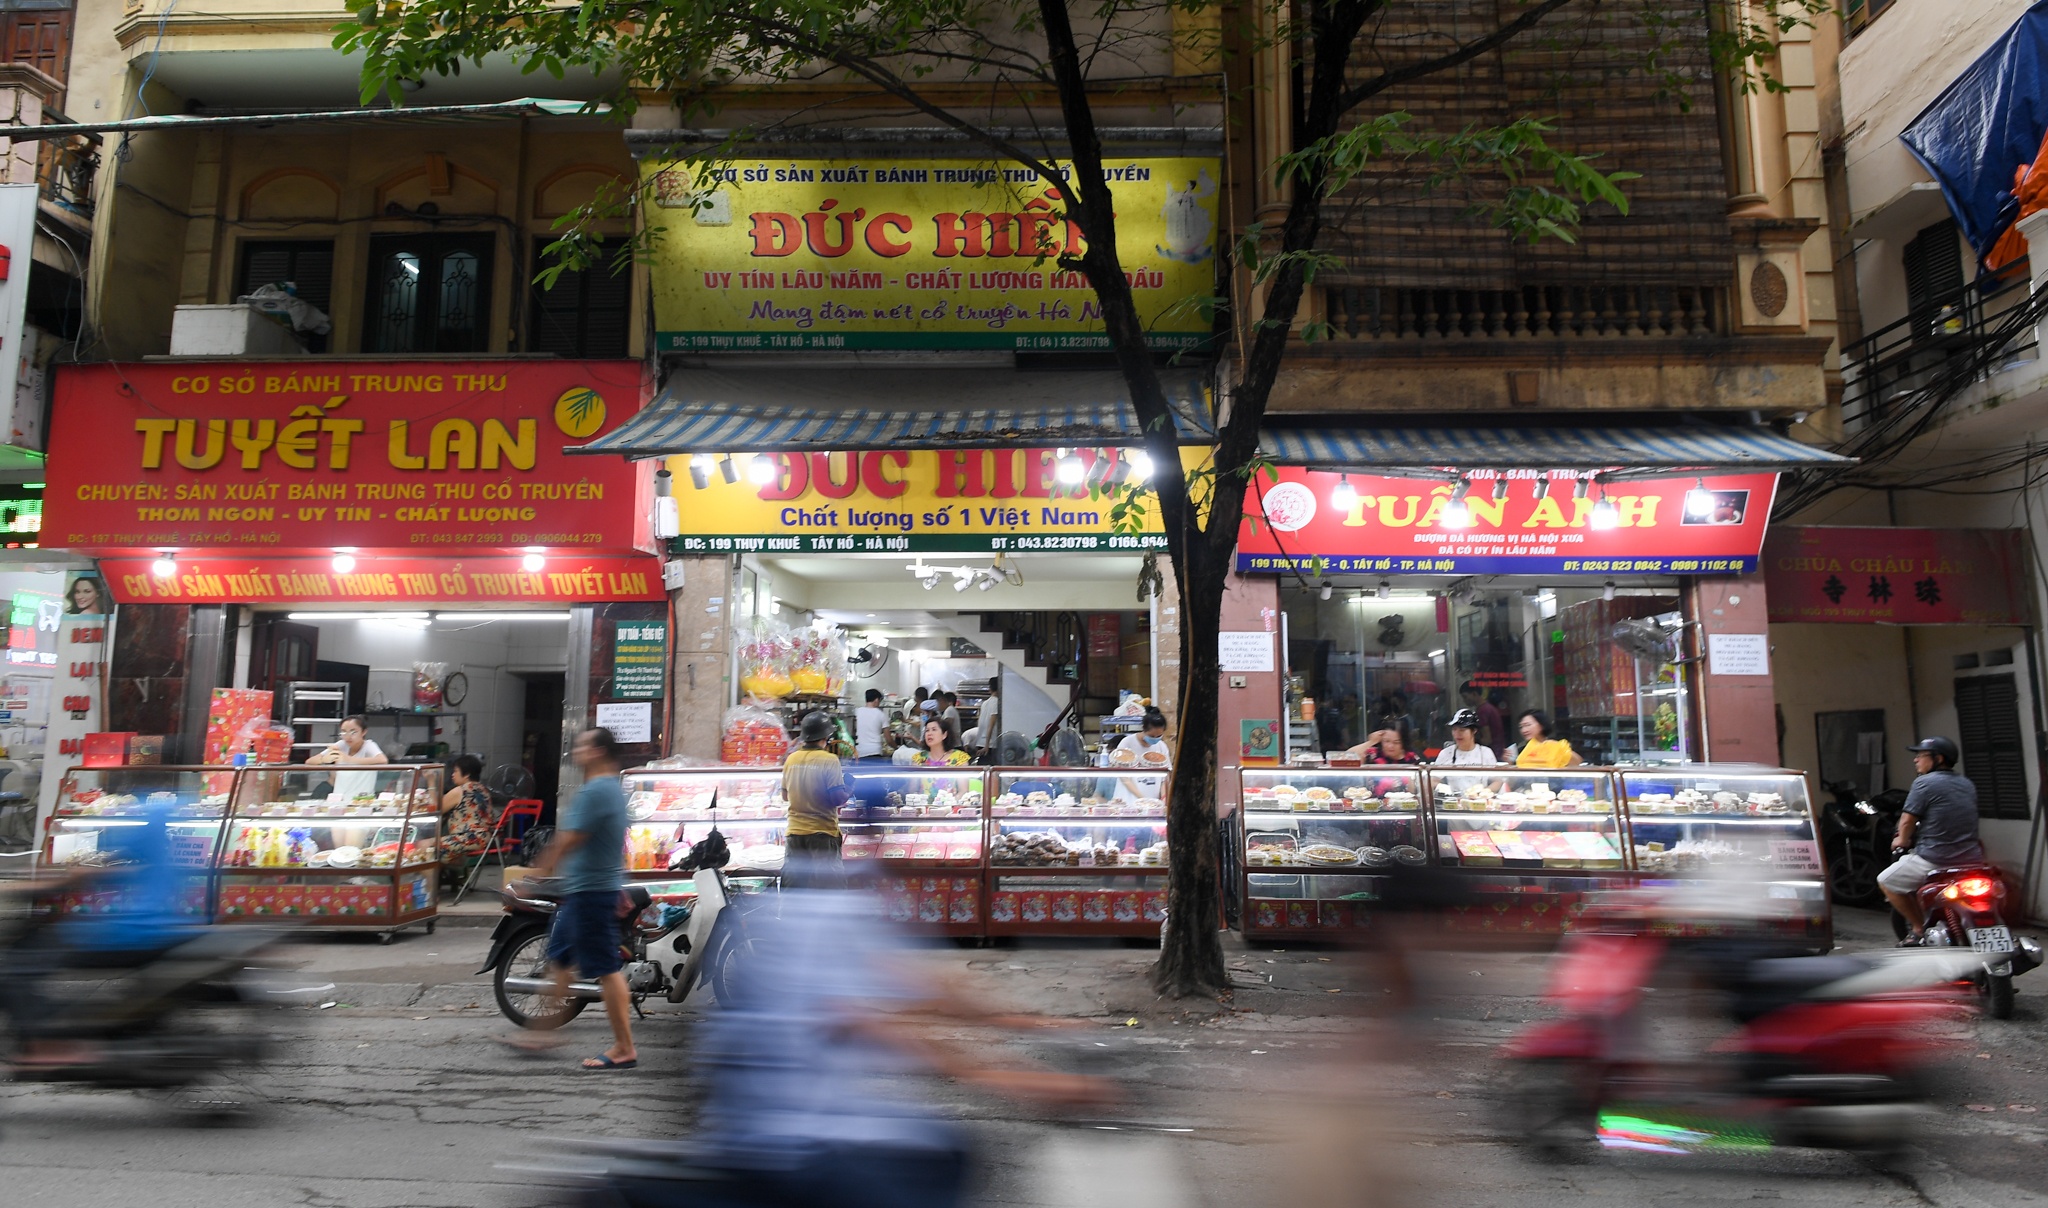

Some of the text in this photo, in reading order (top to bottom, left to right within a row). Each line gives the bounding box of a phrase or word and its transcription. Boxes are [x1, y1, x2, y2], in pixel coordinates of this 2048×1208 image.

[743, 164, 769, 182] SỞ
[775, 164, 814, 182] SẢN
[820, 164, 869, 182] XUẤT
[875, 165, 927, 182] BÁNH
[934, 169, 997, 183] TRUNG
[749, 198, 913, 258] ĐỨC
[704, 272, 732, 289] UY
[739, 269, 775, 289] TÍN
[782, 269, 823, 289] LÂU
[831, 269, 882, 289] NĂM
[906, 267, 962, 289] CHẤT
[969, 271, 1042, 293] LƯỢNG
[748, 300, 815, 328] Mang
[819, 301, 866, 325] đậm
[874, 301, 914, 320] nét
[921, 300, 948, 320] cổ
[955, 301, 1031, 328] truyền
[1036, 299, 1071, 321] Hà
[691, 336, 709, 346] 199
[171, 369, 507, 394] CƠ SỞ BÁNH TRUNG THU
[134, 395, 537, 470] TUYẾT LAN
[77, 481, 168, 501] CHUYÊN:
[175, 479, 218, 500] SẢN
[224, 477, 280, 500] XUẤT
[287, 480, 346, 500] BÁNH
[355, 483, 426, 500] TRUNG
[433, 483, 475, 500] THU
[482, 476, 512, 500] CỔ
[137, 502, 536, 525] THƠM NGON UY TÍN CHẤT LƯỢNG
[781, 504, 1099, 531] Chất lượng số 1 Việt Nam
[91, 534, 110, 543] 197
[432, 534, 452, 543] 043
[455, 534, 474, 543] 847
[476, 534, 503, 543] 2993
[582, 533, 602, 543] 279
[684, 538, 706, 550] ĐC:
[708, 538, 732, 550] 199
[734, 538, 763, 552] THỤY
[811, 536, 835, 550] TÂY
[866, 535, 883, 549] HÀ
[887, 535, 909, 552] NỘI
[992, 537, 1007, 549] ĐT
[1018, 537, 1097, 549] 043.8230798
[1251, 559, 1269, 569] 199
[1353, 558, 1373, 569] TÂY
[1417, 558, 1432, 570] HÀ
[1435, 558, 1455, 572] NỘI
[1583, 561, 1608, 571] 0243
[1611, 561, 1632, 571] 823
[1701, 560, 1726, 571] 1102
[1778, 552, 1843, 573] CHÙA
[1850, 554, 1914, 574] CHÂU
[122, 573, 152, 597] CƠ
[182, 566, 225, 597] SẢN
[224, 567, 275, 597] XUẤT
[276, 570, 333, 596] BÁNH
[332, 573, 398, 596] TRUNG
[399, 573, 438, 595] THU
[440, 563, 468, 595] CỔ
[548, 565, 604, 595] TUYẾT
[608, 573, 647, 595] LAN
